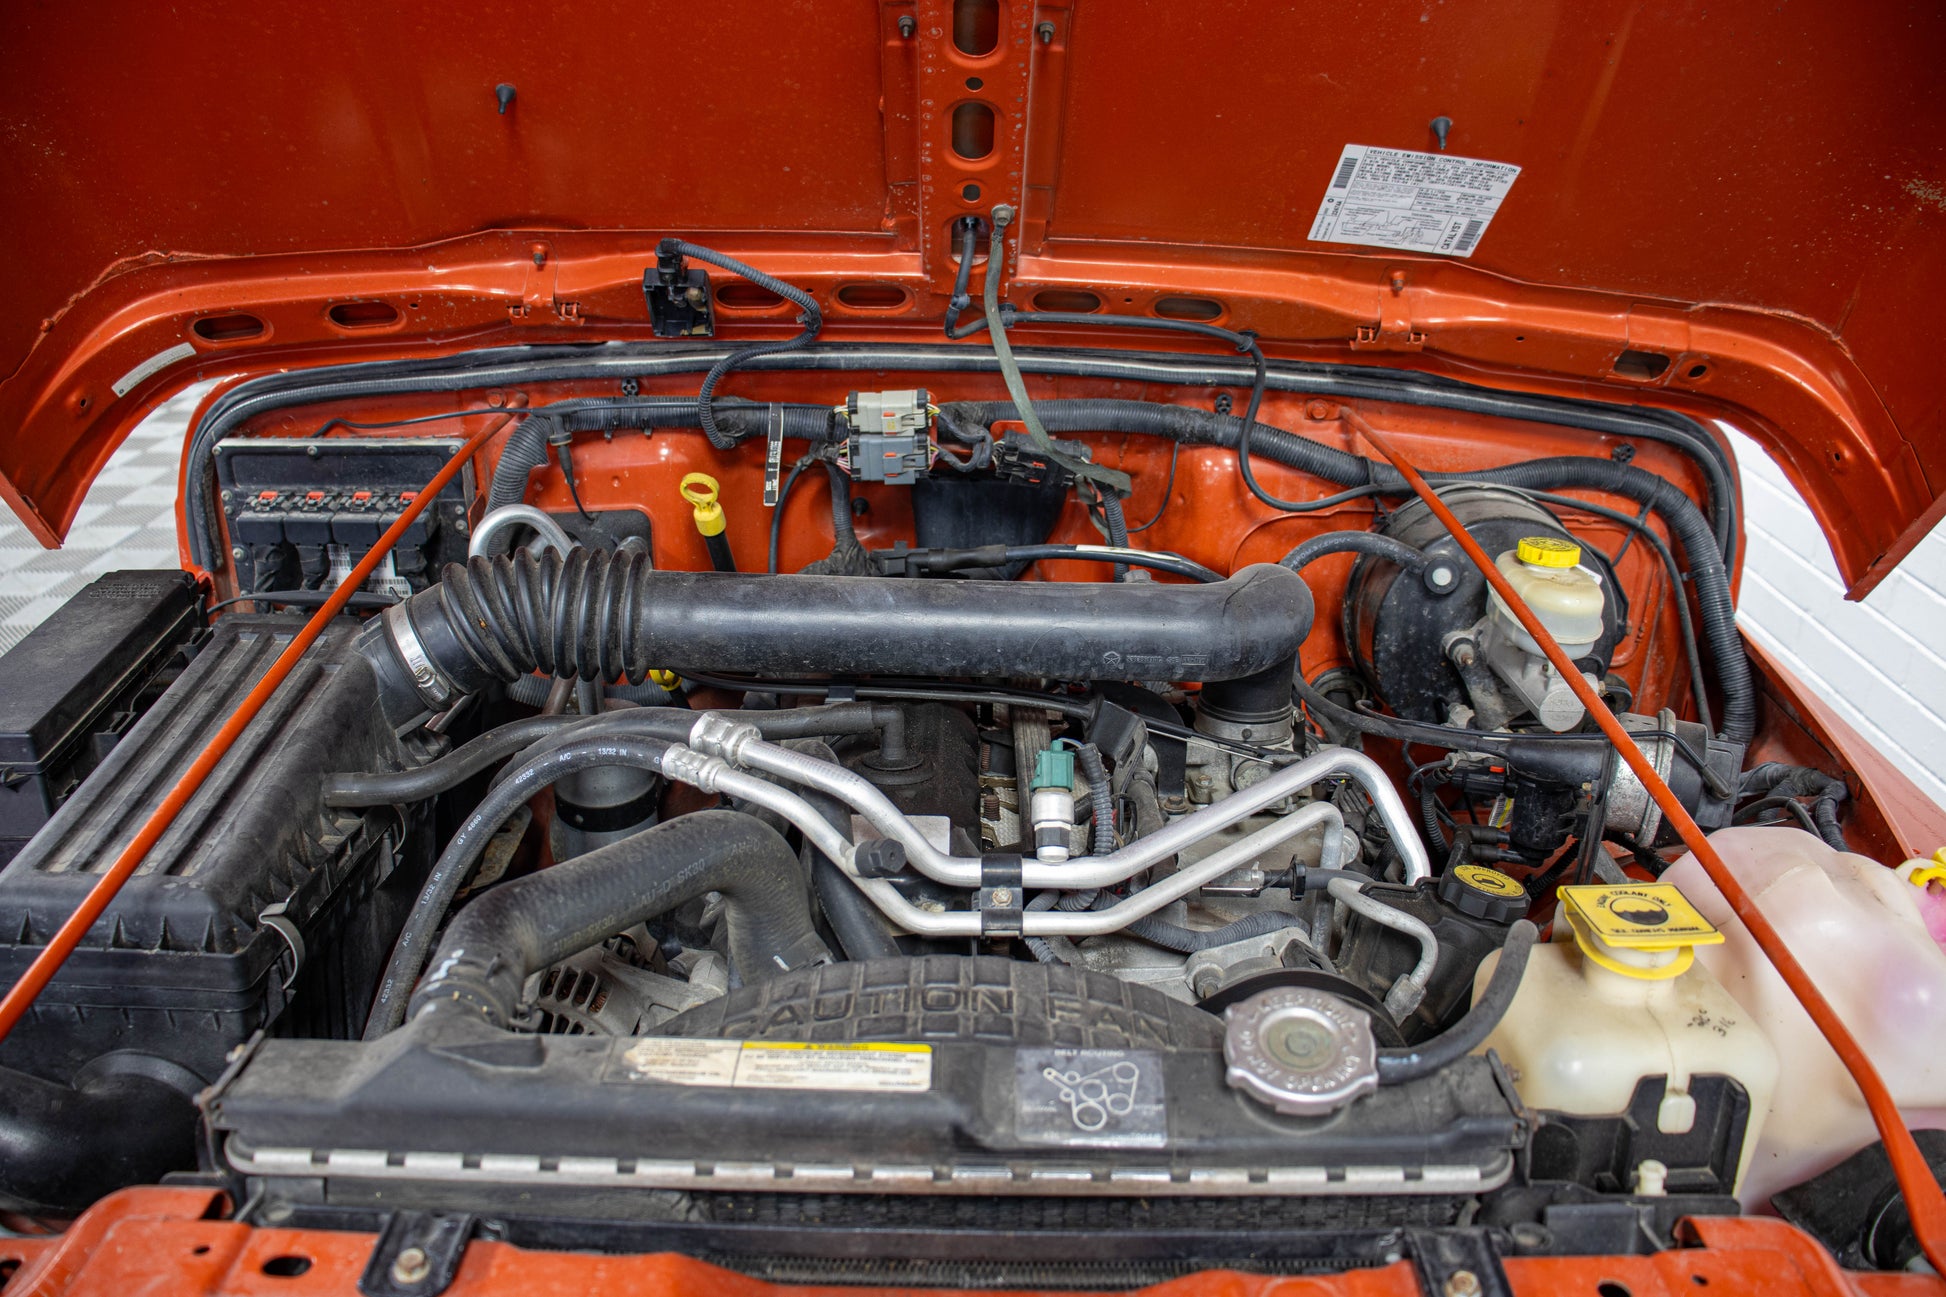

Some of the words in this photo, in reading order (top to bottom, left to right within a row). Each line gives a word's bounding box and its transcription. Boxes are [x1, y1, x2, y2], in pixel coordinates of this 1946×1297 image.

[1402, 153, 1436, 161] EMISSION
[1439, 157, 1466, 165] CONTROL
[1472, 162, 1517, 173] INFORMATION
[1441, 221, 1462, 250] CATALYST
[515, 768, 534, 784] 42332
[559, 752, 571, 761] A/C
[676, 858, 705, 884] SK30
[1609, 889, 1648, 898] COOLANT
[381, 979, 393, 1004] 42332
[402, 932, 412, 947] A/C
[421, 884, 435, 904] 13/32
[433, 872, 442, 882] IN
[457, 832, 467, 845] GY
[718, 986, 1015, 1039] CAUTION
[1049, 998, 1178, 1051] FAN
[1054, 1049, 1078, 1057] BELT
[1080, 1049, 1125, 1058] ROUTING
